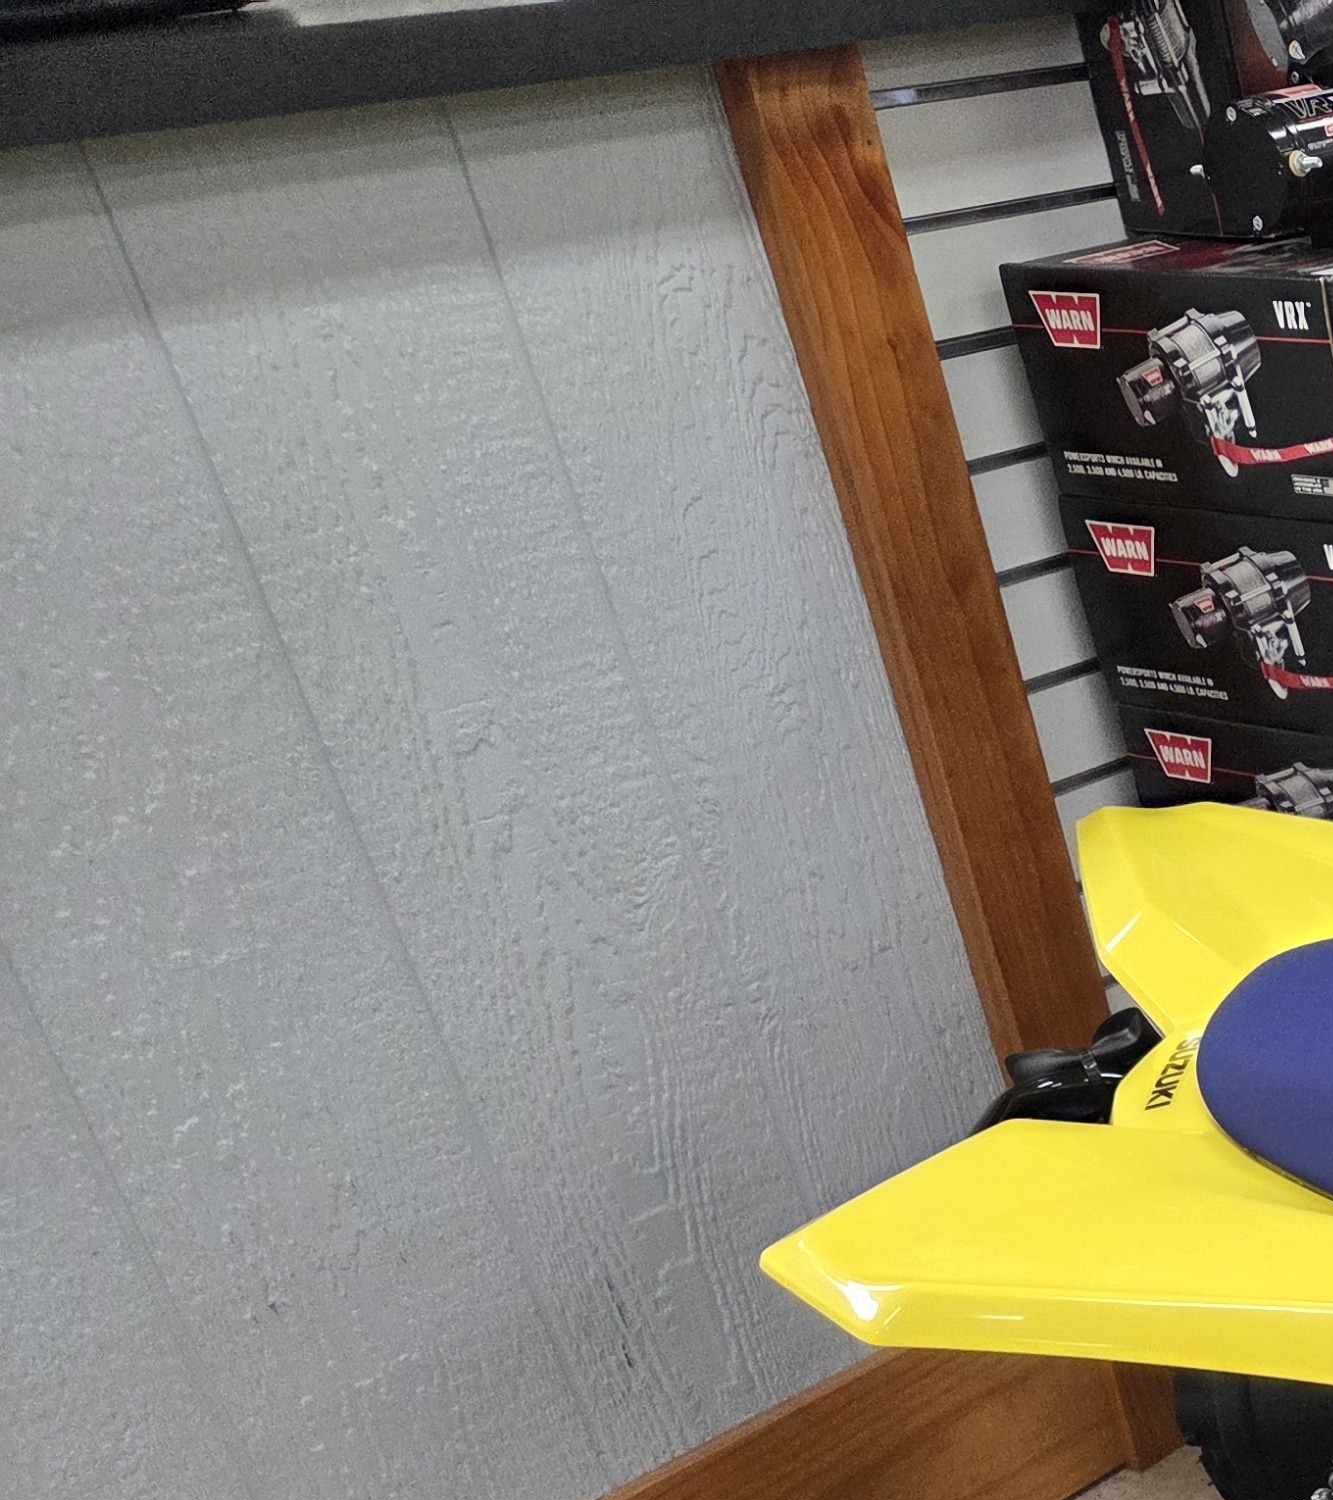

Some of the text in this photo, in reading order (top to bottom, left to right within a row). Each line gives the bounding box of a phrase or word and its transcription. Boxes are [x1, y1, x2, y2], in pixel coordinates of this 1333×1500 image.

[1045, 308, 1095, 332] WARN
[1272, 300, 1309, 331] VRX
[1100, 536, 1149, 562] WARN
[1159, 743, 1205, 769] WARN
[1144, 1036, 1203, 1111] SUZUKI
